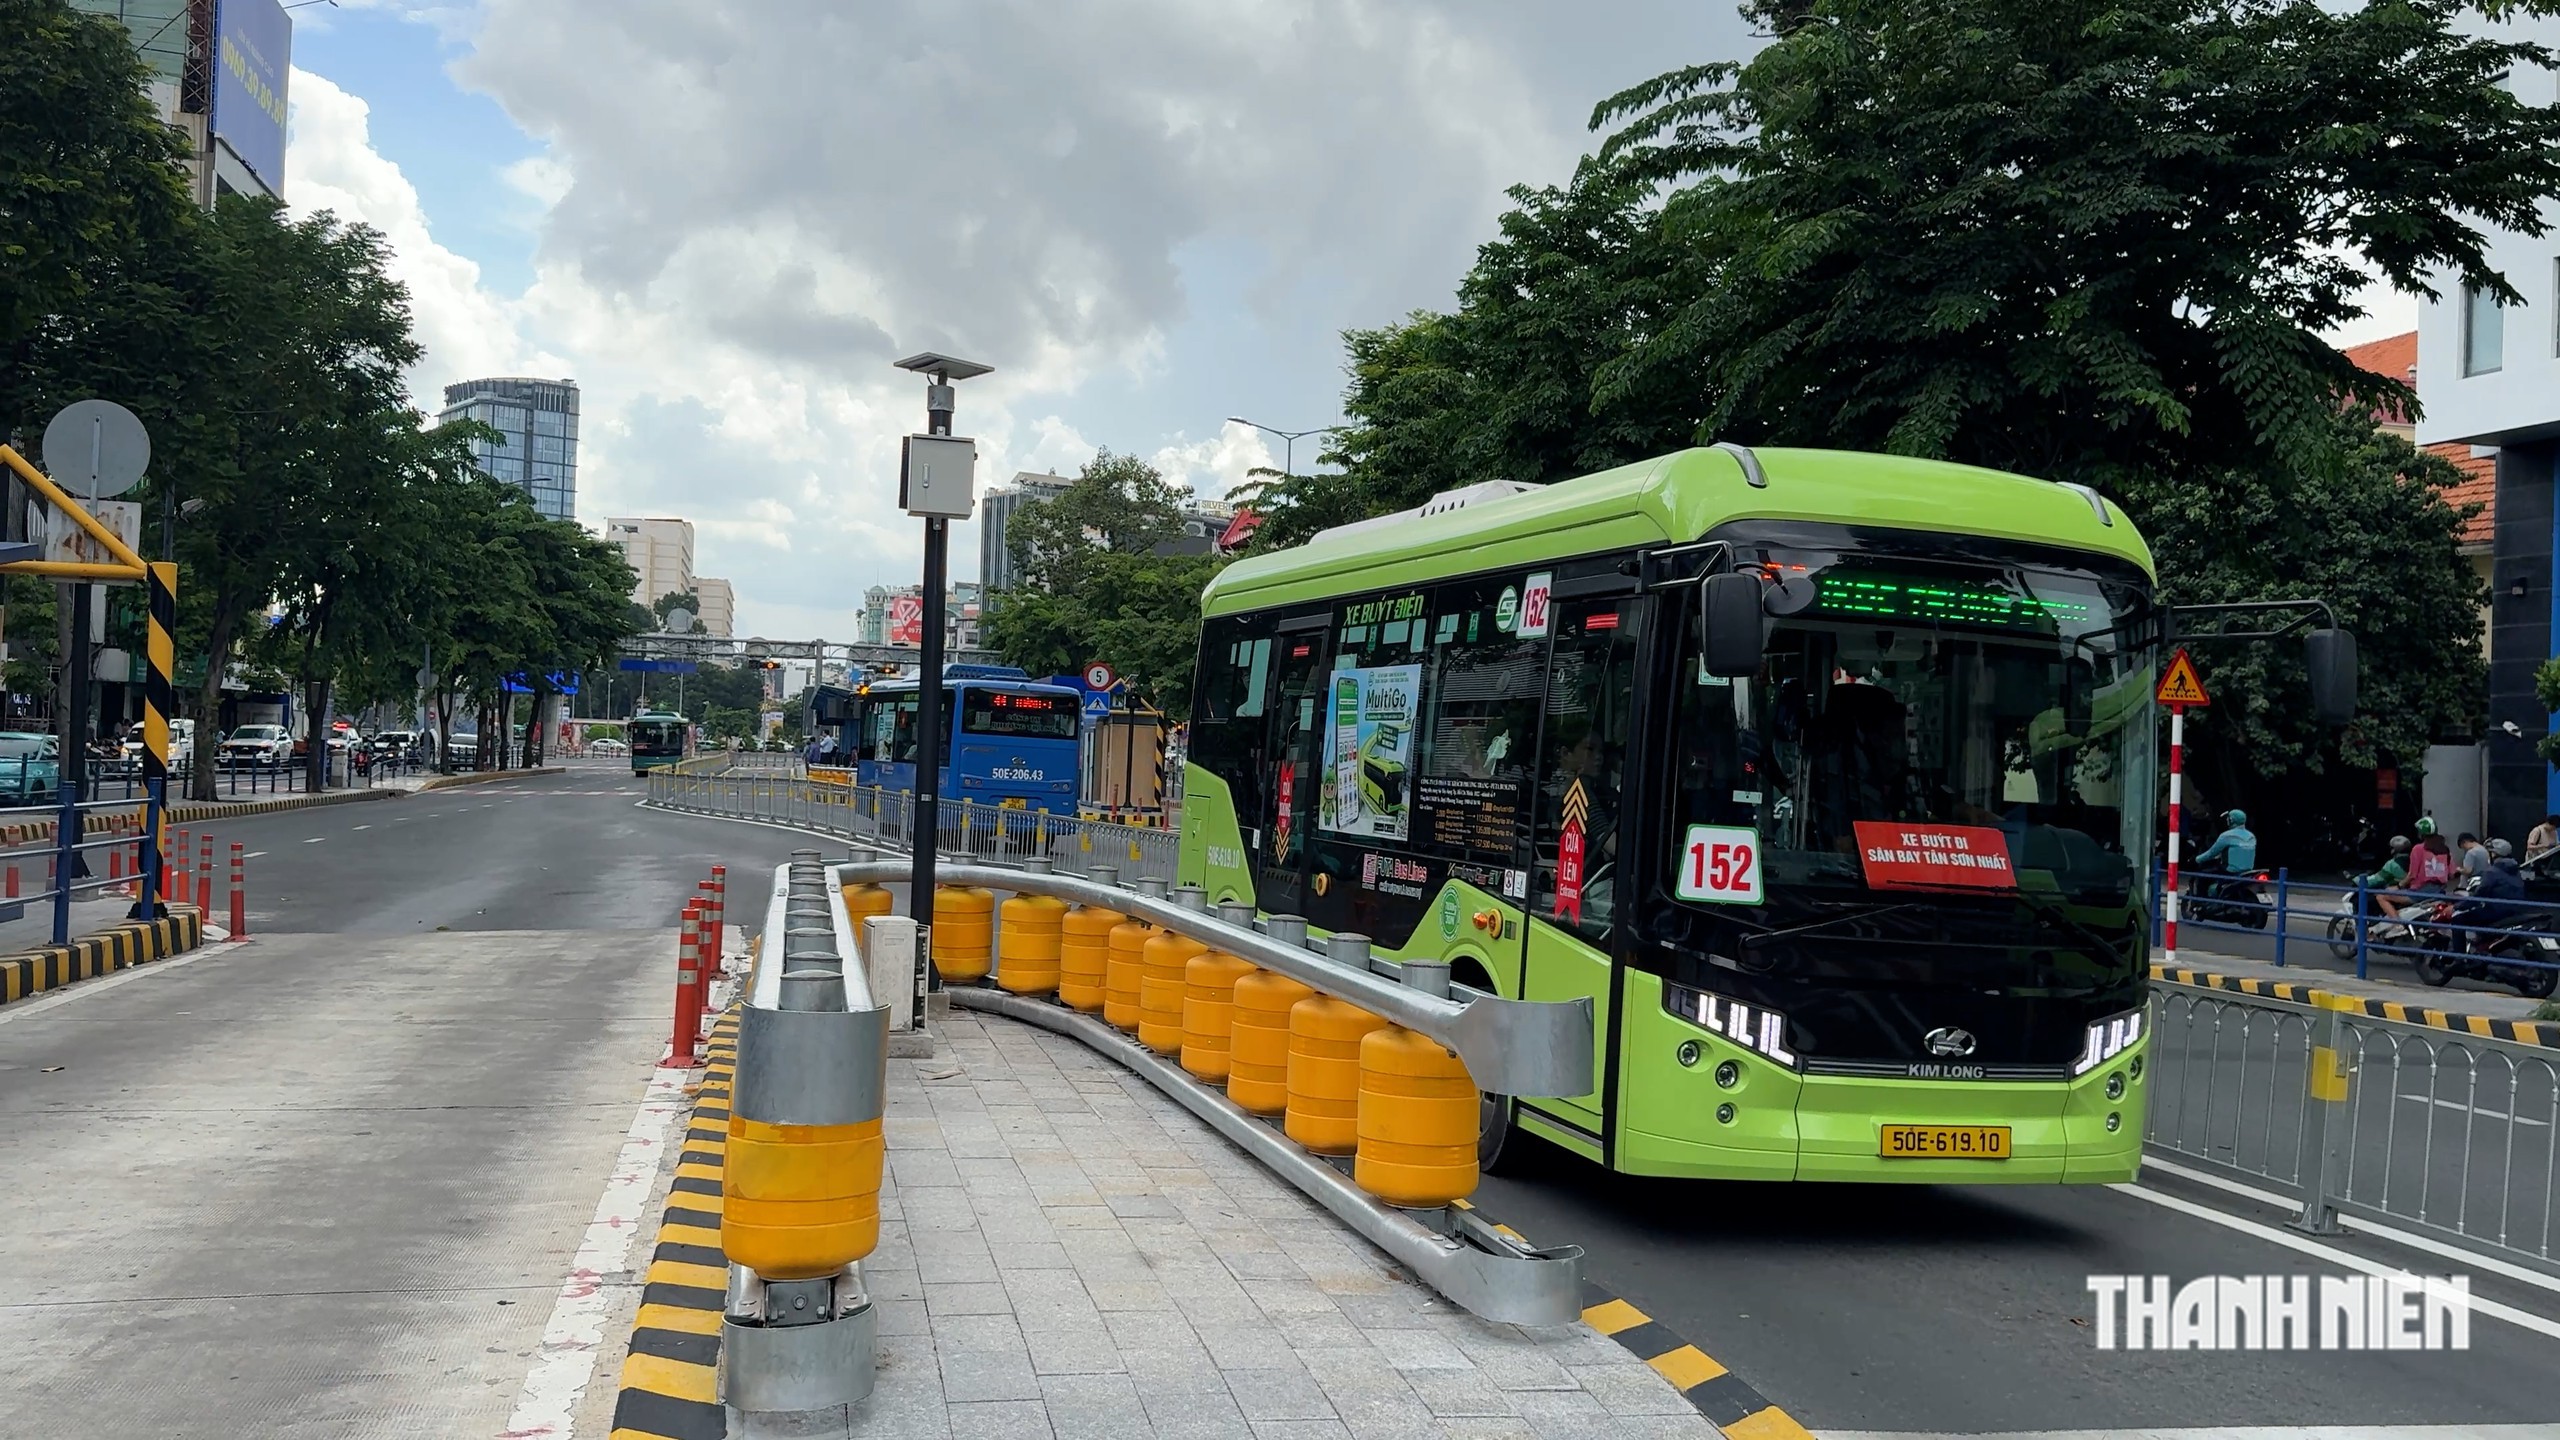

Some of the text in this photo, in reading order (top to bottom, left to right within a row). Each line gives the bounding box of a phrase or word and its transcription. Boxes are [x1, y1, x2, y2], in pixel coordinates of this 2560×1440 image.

[222, 35, 285, 128] 0969.39.89.89
[1344, 606, 1361, 626] XE
[1361, 595, 1394, 624] BUÝT
[1524, 587, 1548, 628] 152
[1095, 671, 1102, 683] 5
[1366, 688, 1407, 709] MultiGo
[992, 768, 1044, 781] 50E-206.43
[1565, 826, 1579, 854] CỬA
[1901, 832, 1969, 850] XE BUÝT ĐI
[1208, 845, 1240, 869] 50E-619.10
[1690, 843, 1753, 891] 152
[1867, 847, 2008, 870] SÂN BAY TÂN SƠN NHẤT
[1562, 857, 1578, 882] LÊN
[1560, 883, 1578, 900] Entrance
[1908, 1063, 1984, 1078] KIM LONG
[1893, 1131, 2000, 1152] 50E-619.10
